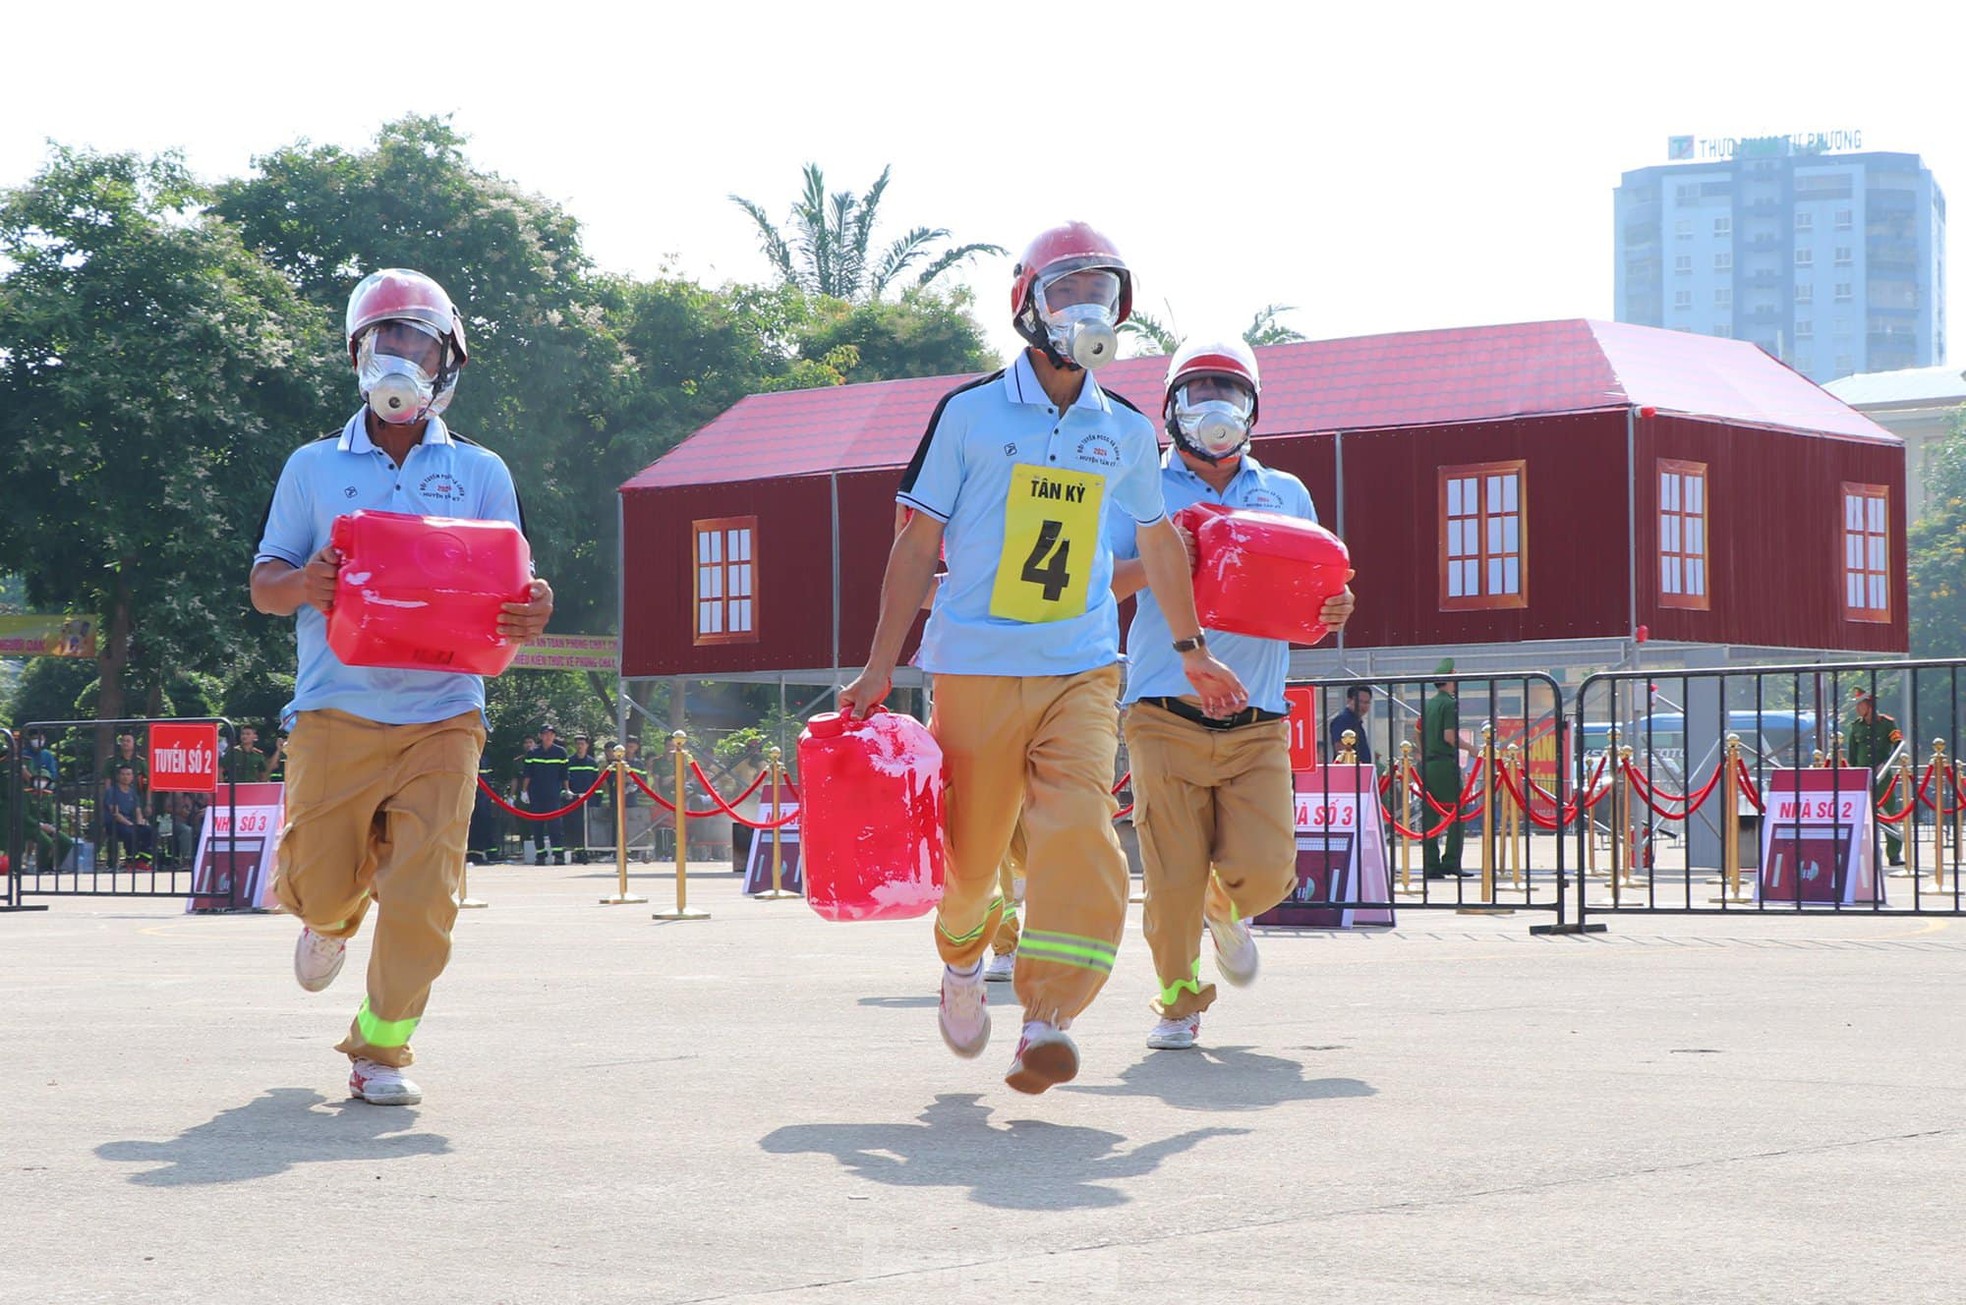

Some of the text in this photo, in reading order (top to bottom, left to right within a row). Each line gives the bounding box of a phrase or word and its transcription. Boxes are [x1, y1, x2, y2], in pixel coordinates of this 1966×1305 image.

[1031, 477, 1086, 503] TÂN KỲ
[1020, 519, 1070, 602] 4
[1296, 719, 1304, 749] 1
[154, 740, 212, 774] TUYẾN SỐ 2
[213, 816, 233, 831] NH
[240, 810, 256, 831] SỐ
[258, 816, 267, 831] 3
[1314, 799, 1337, 825] SỐ
[1342, 805, 1353, 825] 3
[1842, 801, 1852, 818] 2
